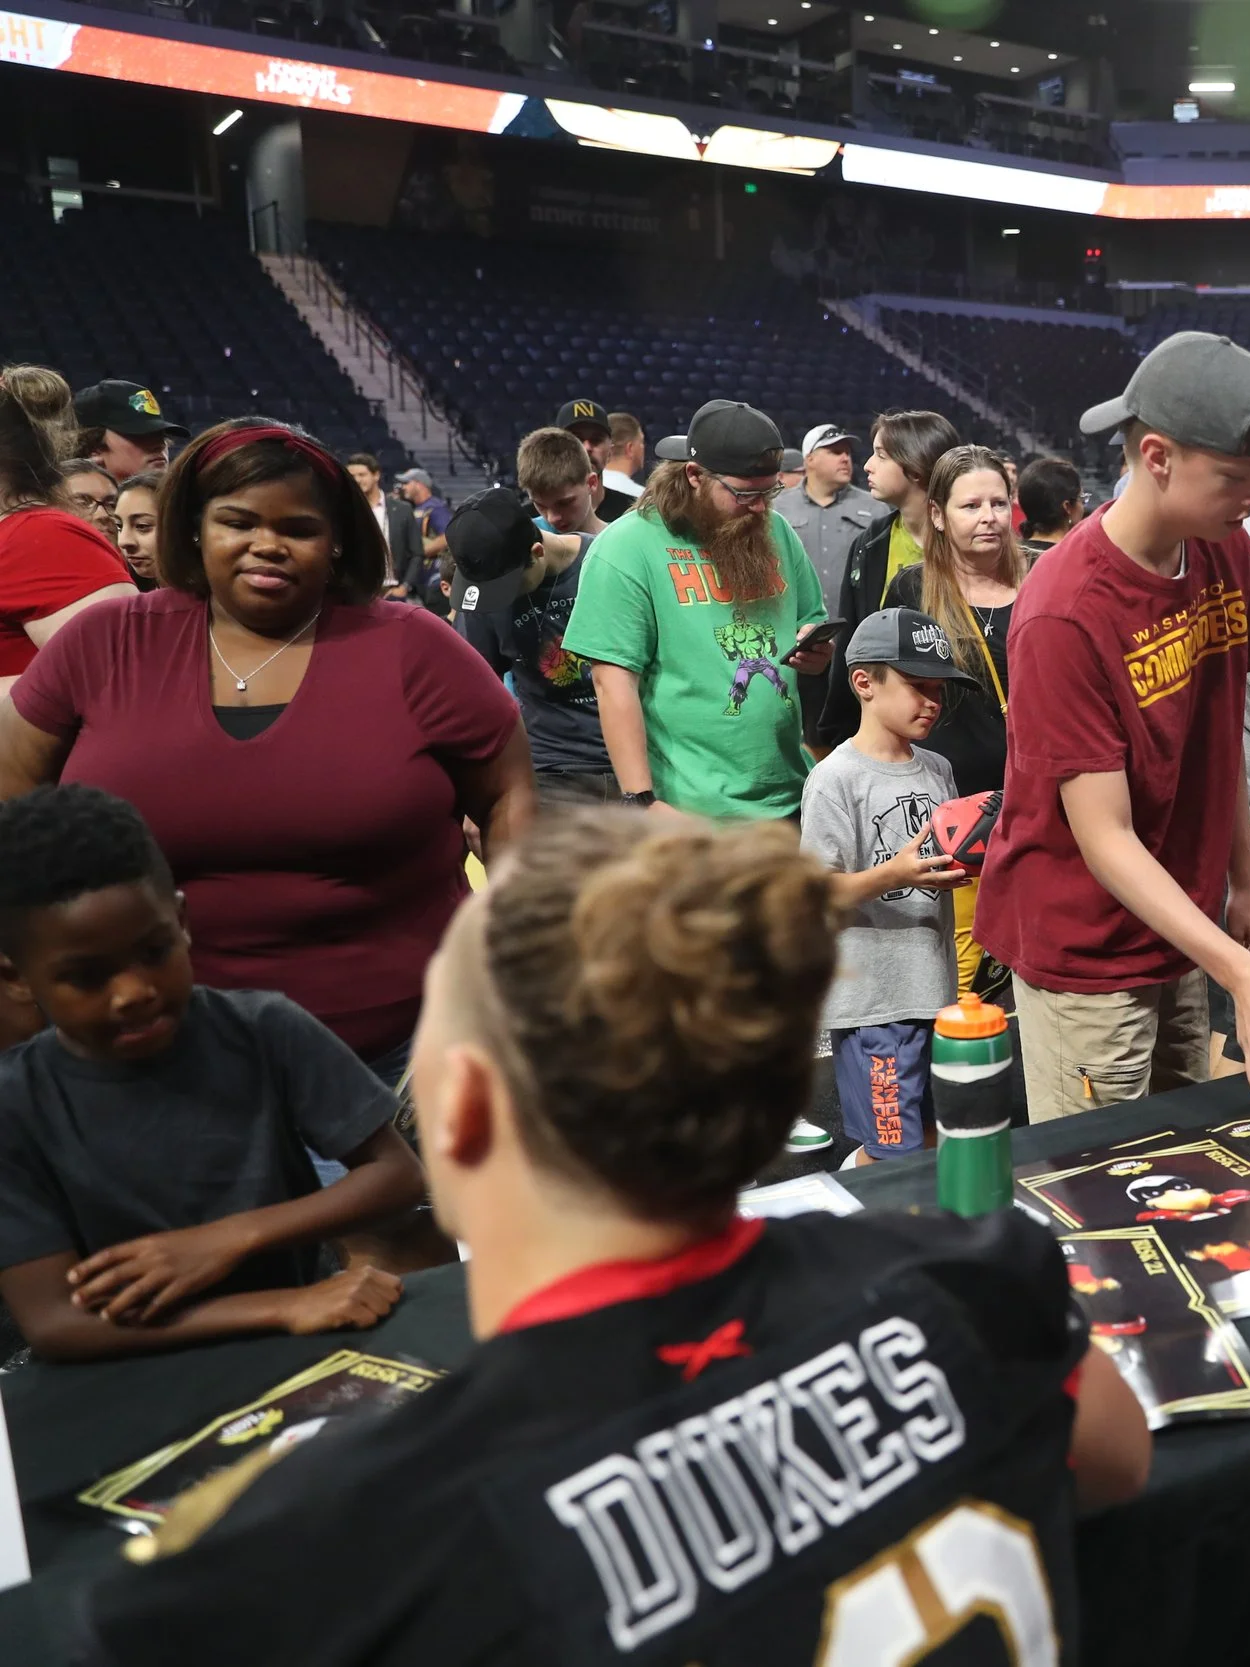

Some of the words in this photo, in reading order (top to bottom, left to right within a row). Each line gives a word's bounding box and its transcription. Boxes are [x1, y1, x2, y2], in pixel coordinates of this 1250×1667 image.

[666, 548, 695, 560] THE
[1128, 600, 1248, 697] COMMNDES
[870, 1056, 889, 1145] ARMOUR
[884, 1075, 903, 1145] UNDER
[545, 1316, 966, 1652] DUKES
